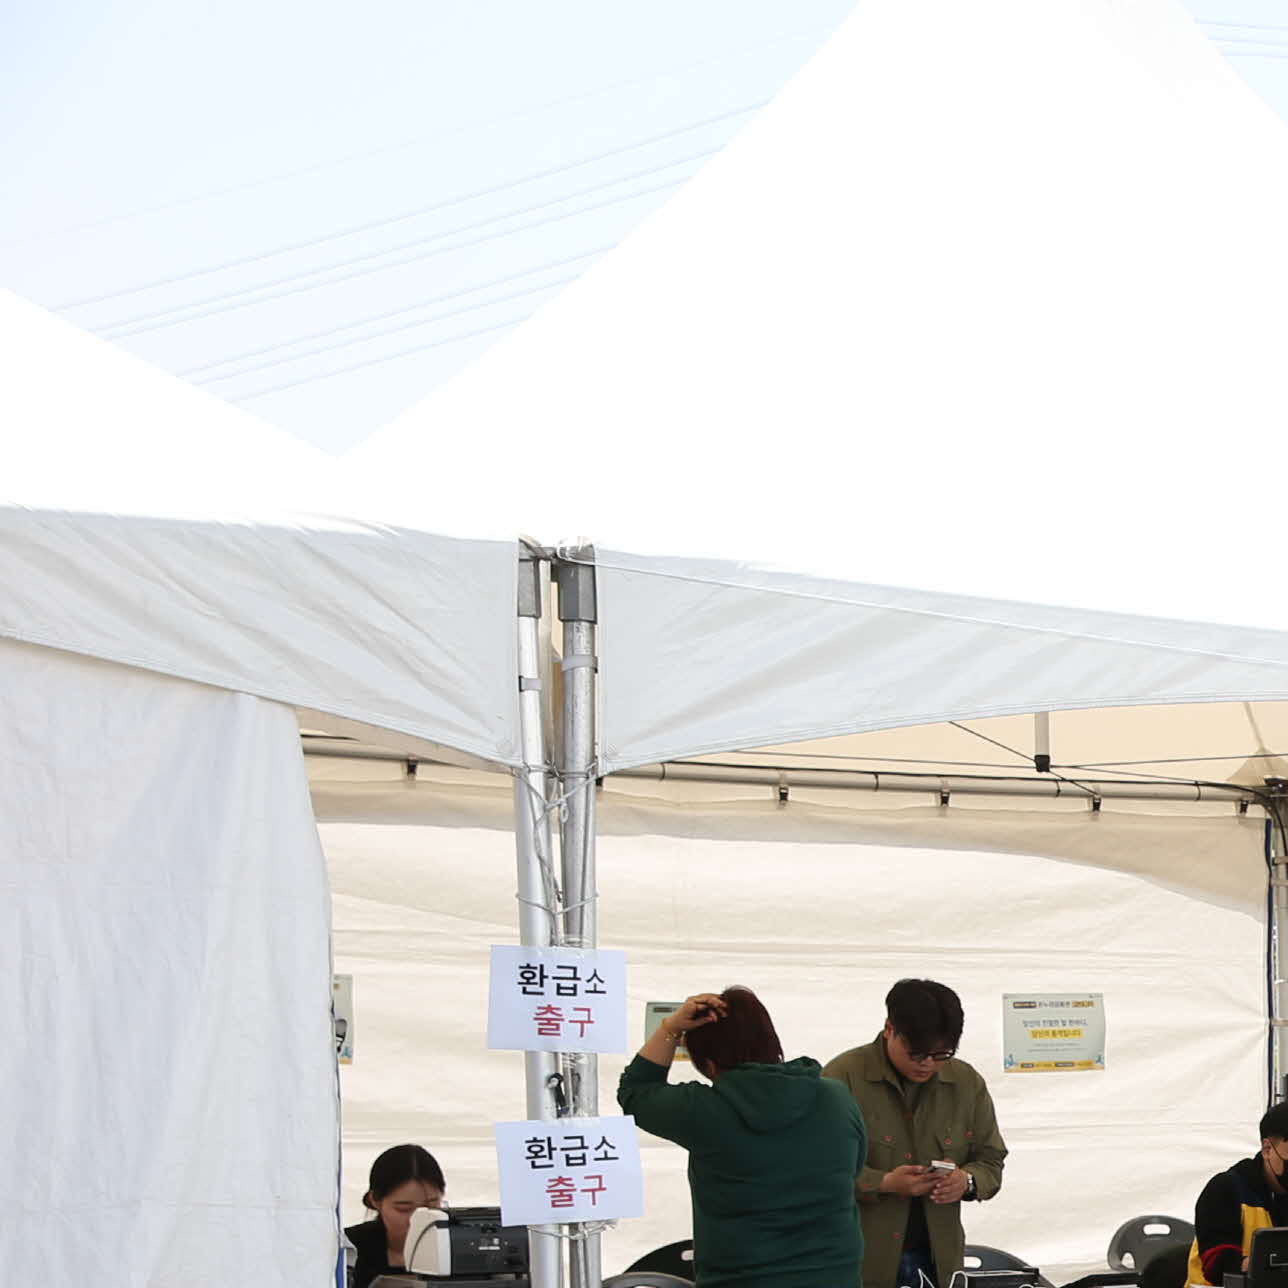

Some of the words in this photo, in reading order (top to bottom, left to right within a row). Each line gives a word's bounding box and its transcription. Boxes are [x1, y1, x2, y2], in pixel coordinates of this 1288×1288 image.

[518, 963, 607, 997] 환급소
[533, 1005, 594, 1037] 출구
[525, 1135, 619, 1169] 환급소
[545, 1174, 607, 1208] 출구
